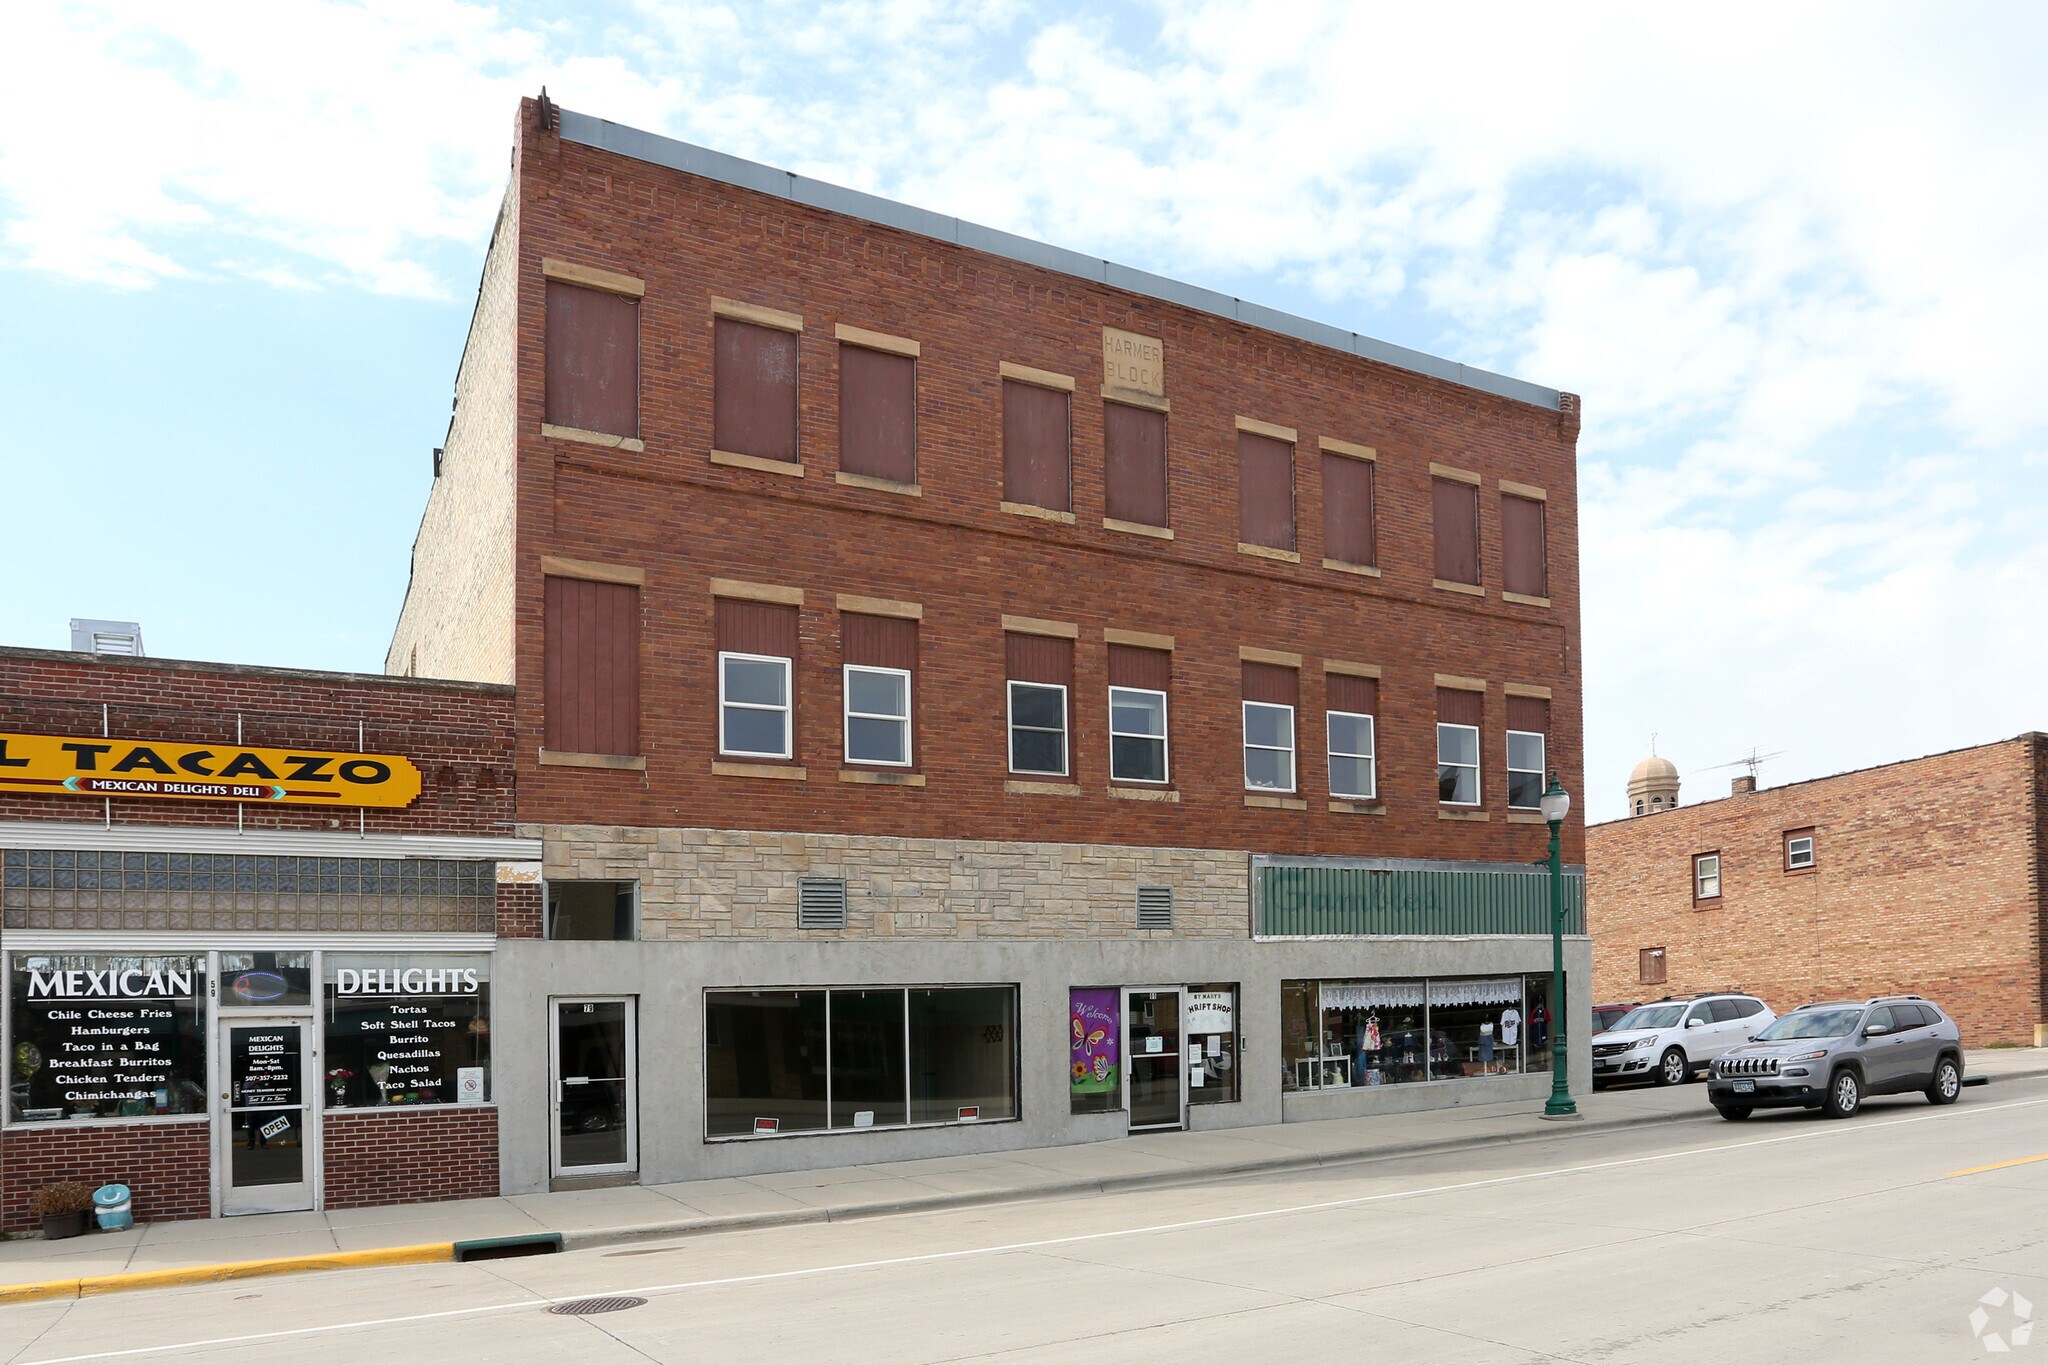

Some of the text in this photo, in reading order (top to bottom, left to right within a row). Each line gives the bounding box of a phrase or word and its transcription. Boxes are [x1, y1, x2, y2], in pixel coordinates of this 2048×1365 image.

[1104, 336, 1160, 362] HARMER
[1106, 361, 1160, 387] BLOCK
[61, 743, 392, 784] TACAZO
[92, 780, 259, 796] MEXICAN DELIGHTS DELI
[27, 969, 192, 997] MEXICAN
[338, 968, 478, 994] DELIGHTS
[48, 1009, 172, 1019] Chile Cheese Fries
[390, 1006, 428, 1014] Tortas
[1075, 1002, 1113, 1024] Welcome
[1188, 1003, 1231, 1014] HRIFT SHOP
[361, 1020, 456, 1030] Soft Shell Tacos
[71, 1026, 150, 1036] Hamburgers
[390, 1035, 429, 1044] Burrito
[62, 1043, 95, 1052] Taco
[102, 1042, 113, 1051] in
[135, 1042, 160, 1051] Bag
[378, 1050, 441, 1060] Quesadillas
[50, 1058, 172, 1068] Breakfast Burritos
[390, 1065, 430, 1074] Nachos
[56, 1074, 165, 1084] Chicken Tenders
[377, 1078, 442, 1089] Taco Salad
[65, 1090, 156, 1101] Chimichangas
[263, 1118, 288, 1136] OPEN
